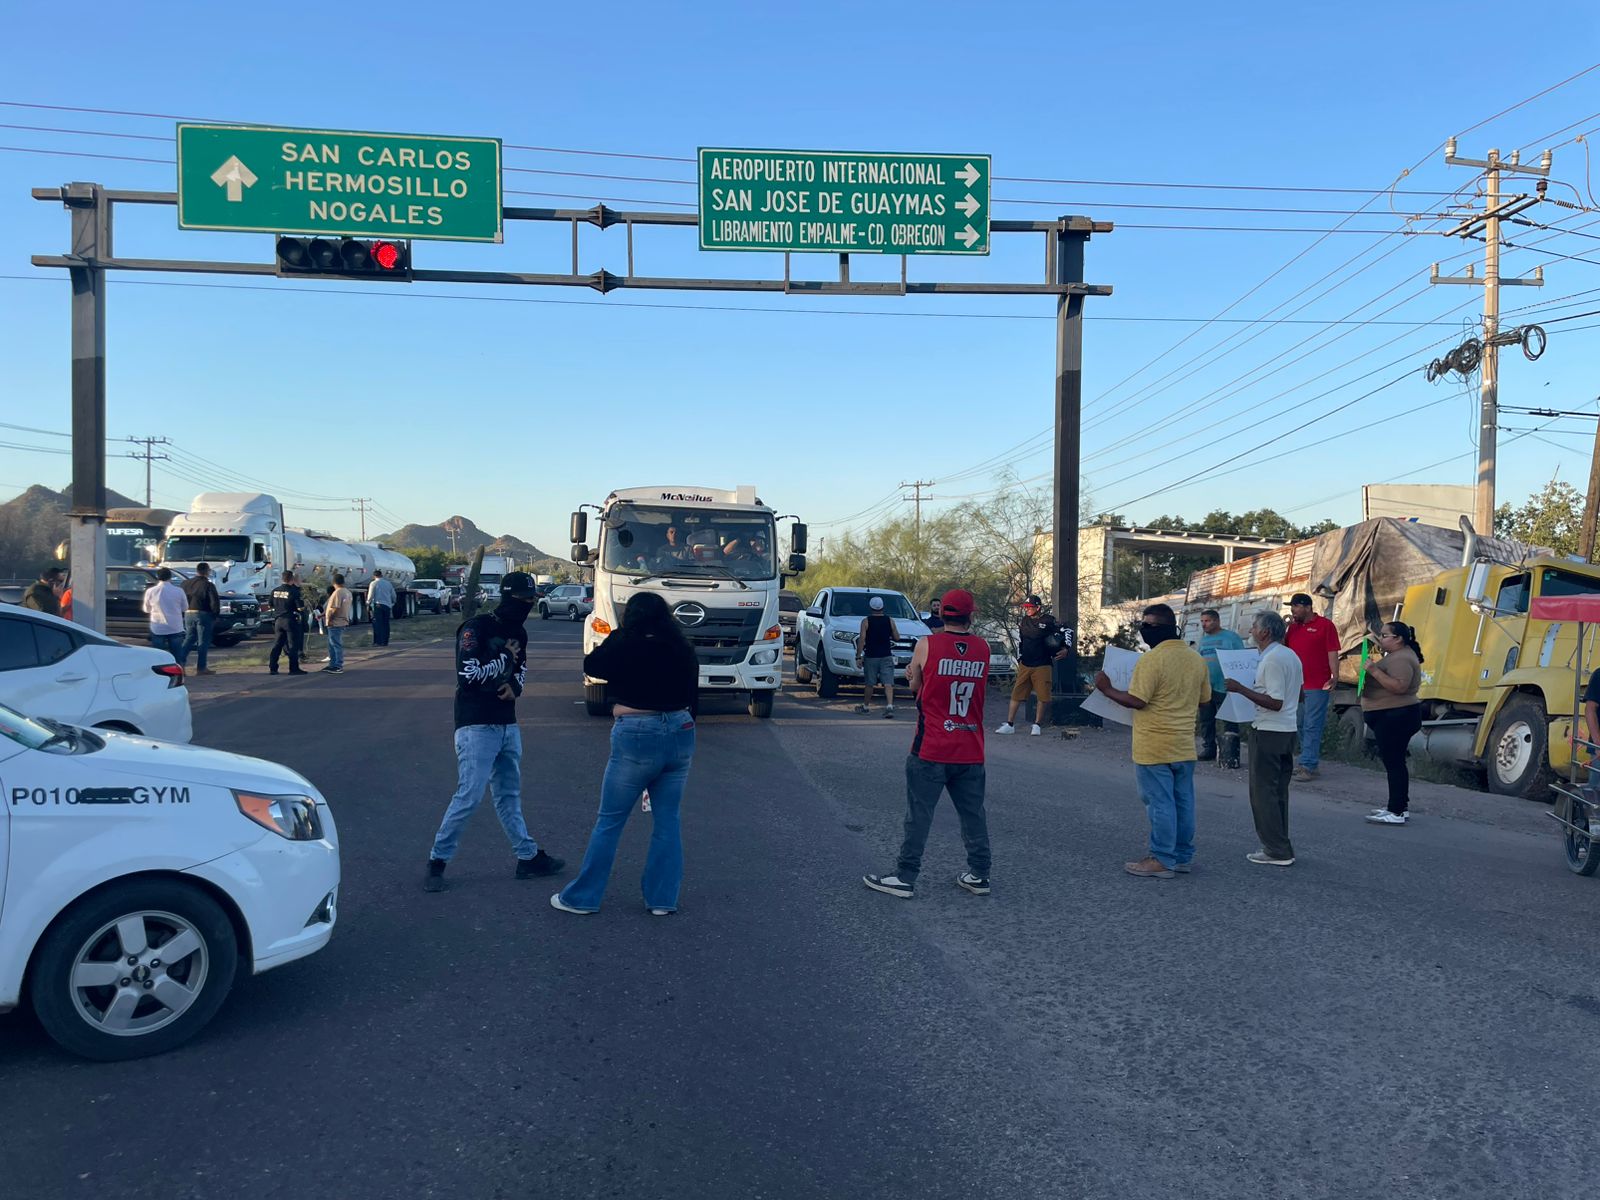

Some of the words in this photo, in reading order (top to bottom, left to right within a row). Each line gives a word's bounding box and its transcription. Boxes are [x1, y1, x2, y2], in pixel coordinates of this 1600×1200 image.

[281, 142, 340, 164] SAN
[357, 146, 471, 171] CARLOS
[285, 171, 468, 198] HERMOSILLO
[710, 157, 815, 182] AEROPUERTO
[823, 160, 946, 185] INTERNACIONAL
[309, 200, 443, 225] NOGALES
[711, 188, 753, 212] SAN
[760, 190, 811, 213] JOSE
[818, 192, 844, 214] DE
[850, 193, 946, 216] GUAYMAS
[711, 219, 793, 243] LIBRAMIENTO
[891, 224, 946, 246] OBREGON
[660, 493, 713, 502] McNeilus
[106, 528, 144, 536] TUFESA
[938, 658, 985, 677] MERAZ
[949, 681, 975, 717] 13
